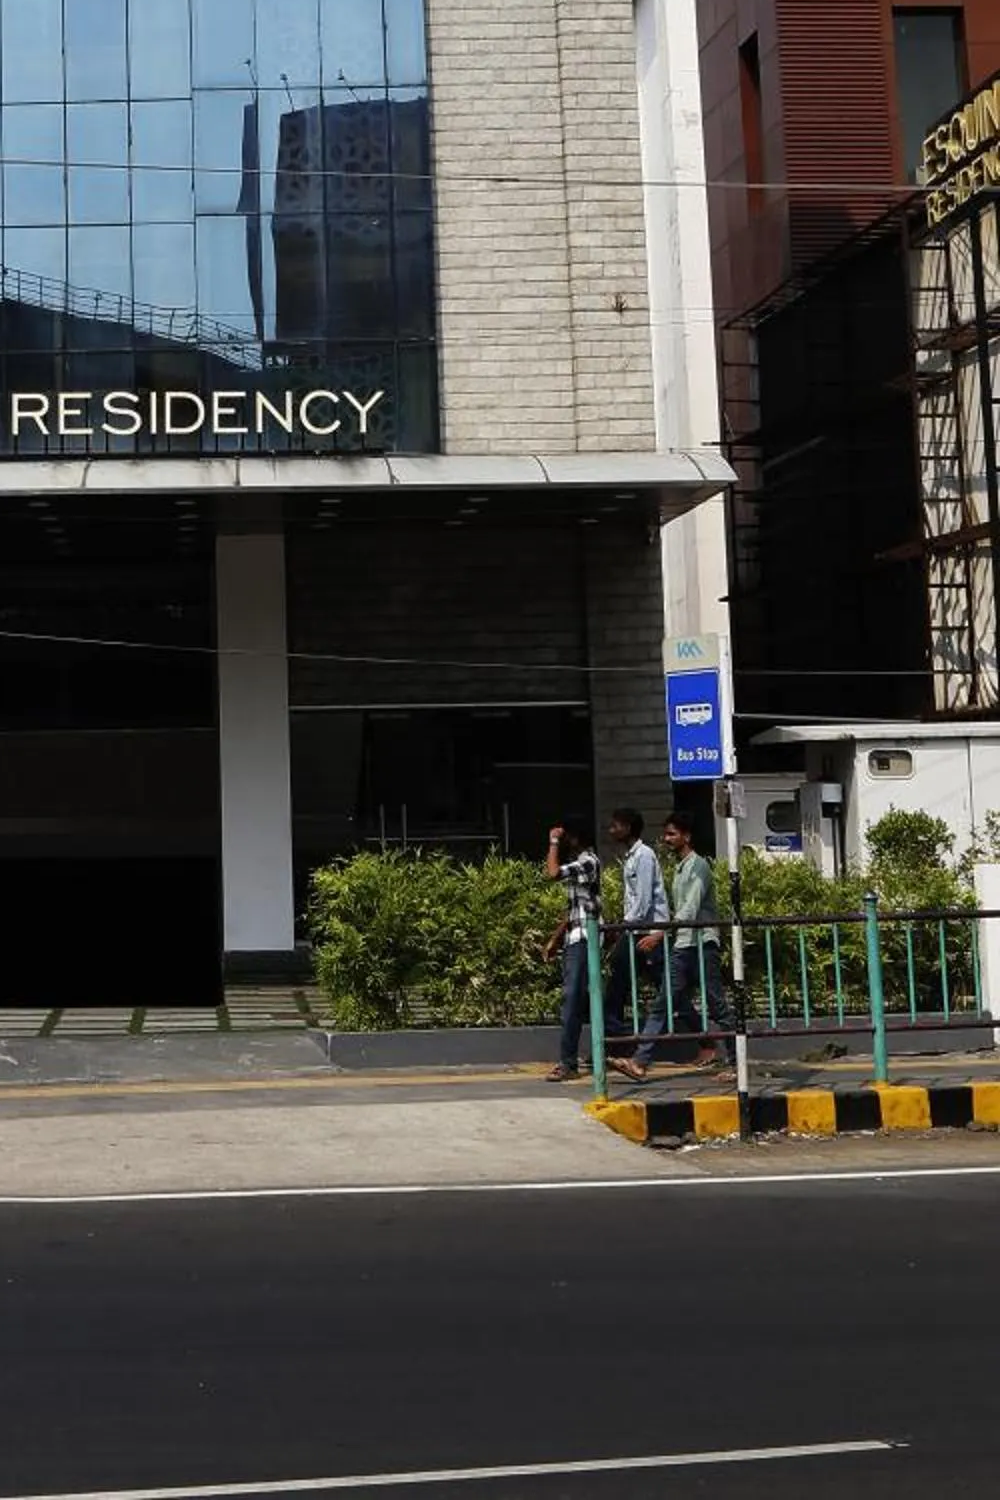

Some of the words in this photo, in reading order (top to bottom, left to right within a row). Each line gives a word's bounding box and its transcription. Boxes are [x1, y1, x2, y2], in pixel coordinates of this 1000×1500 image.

[10, 389, 385, 436] RESIDENCY
[677, 747, 695, 761] Bus
[696, 747, 719, 762] Stop
